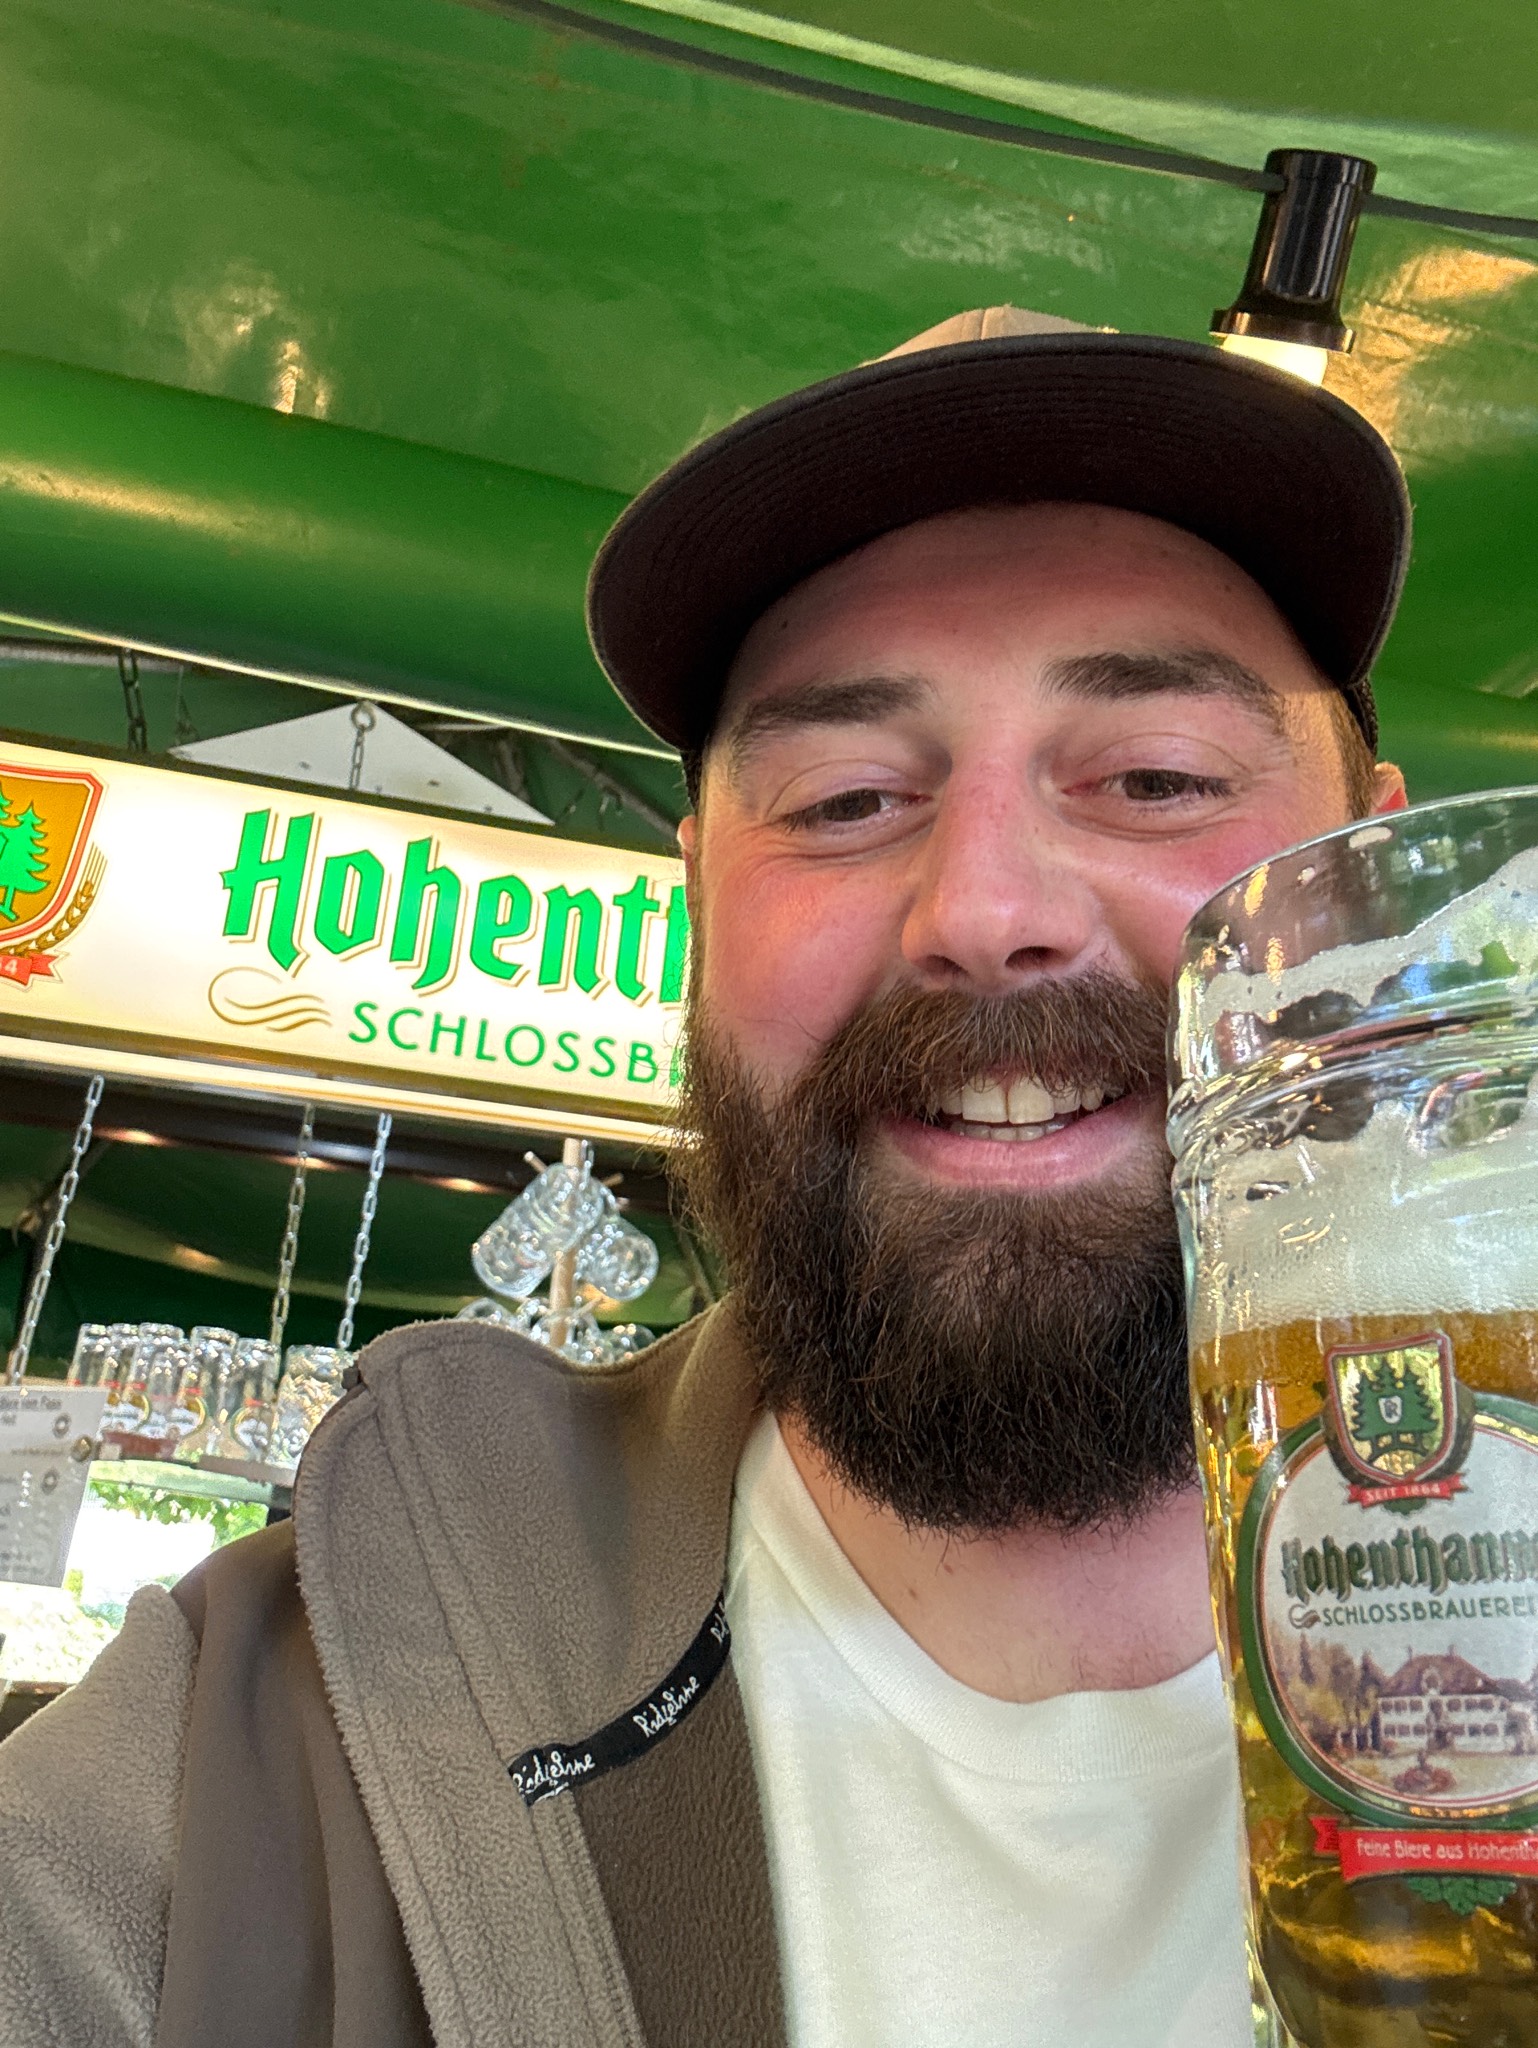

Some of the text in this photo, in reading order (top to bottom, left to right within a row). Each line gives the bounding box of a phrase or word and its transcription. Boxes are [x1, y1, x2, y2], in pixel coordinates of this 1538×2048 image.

[1281, 1525, 1538, 1605] Hohenthann
[1356, 1838, 1391, 1858] Feine
[1395, 1839, 1432, 1859] Biere
[1436, 1843, 1464, 1859] aus
